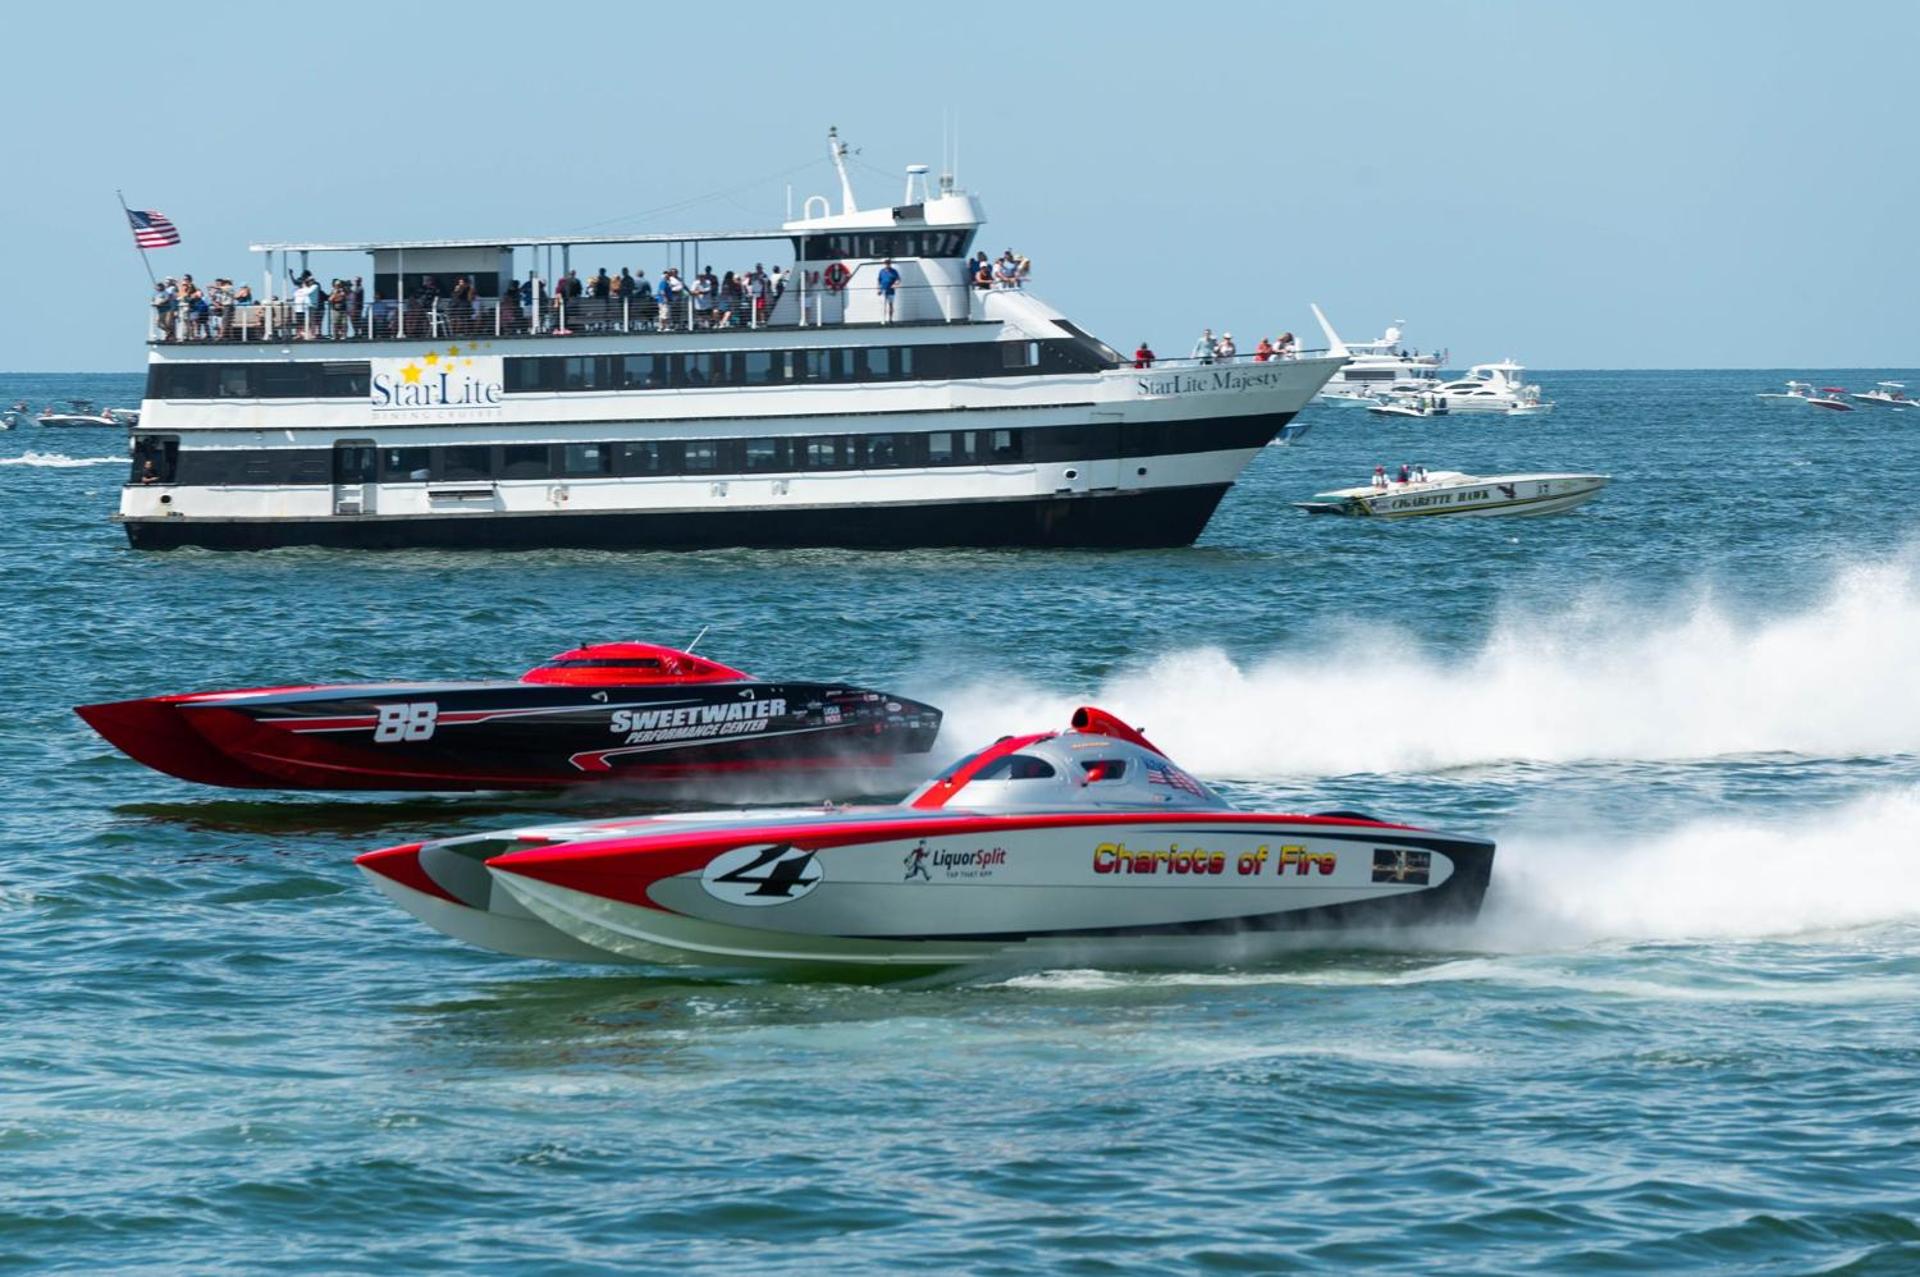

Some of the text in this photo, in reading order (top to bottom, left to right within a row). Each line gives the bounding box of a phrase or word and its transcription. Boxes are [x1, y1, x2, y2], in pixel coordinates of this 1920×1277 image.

[372, 372, 502, 406] StarLite
[1137, 371, 1282, 395] StarLite Majesty
[374, 702, 438, 743] 88
[610, 699, 786, 733] SWEETWATER
[625, 718, 769, 744] PERFORMANCE CENTER
[712, 843, 821, 897] 4
[933, 848, 1007, 870] LiquorSplit
[1093, 842, 1337, 876] Chariots of Fire
